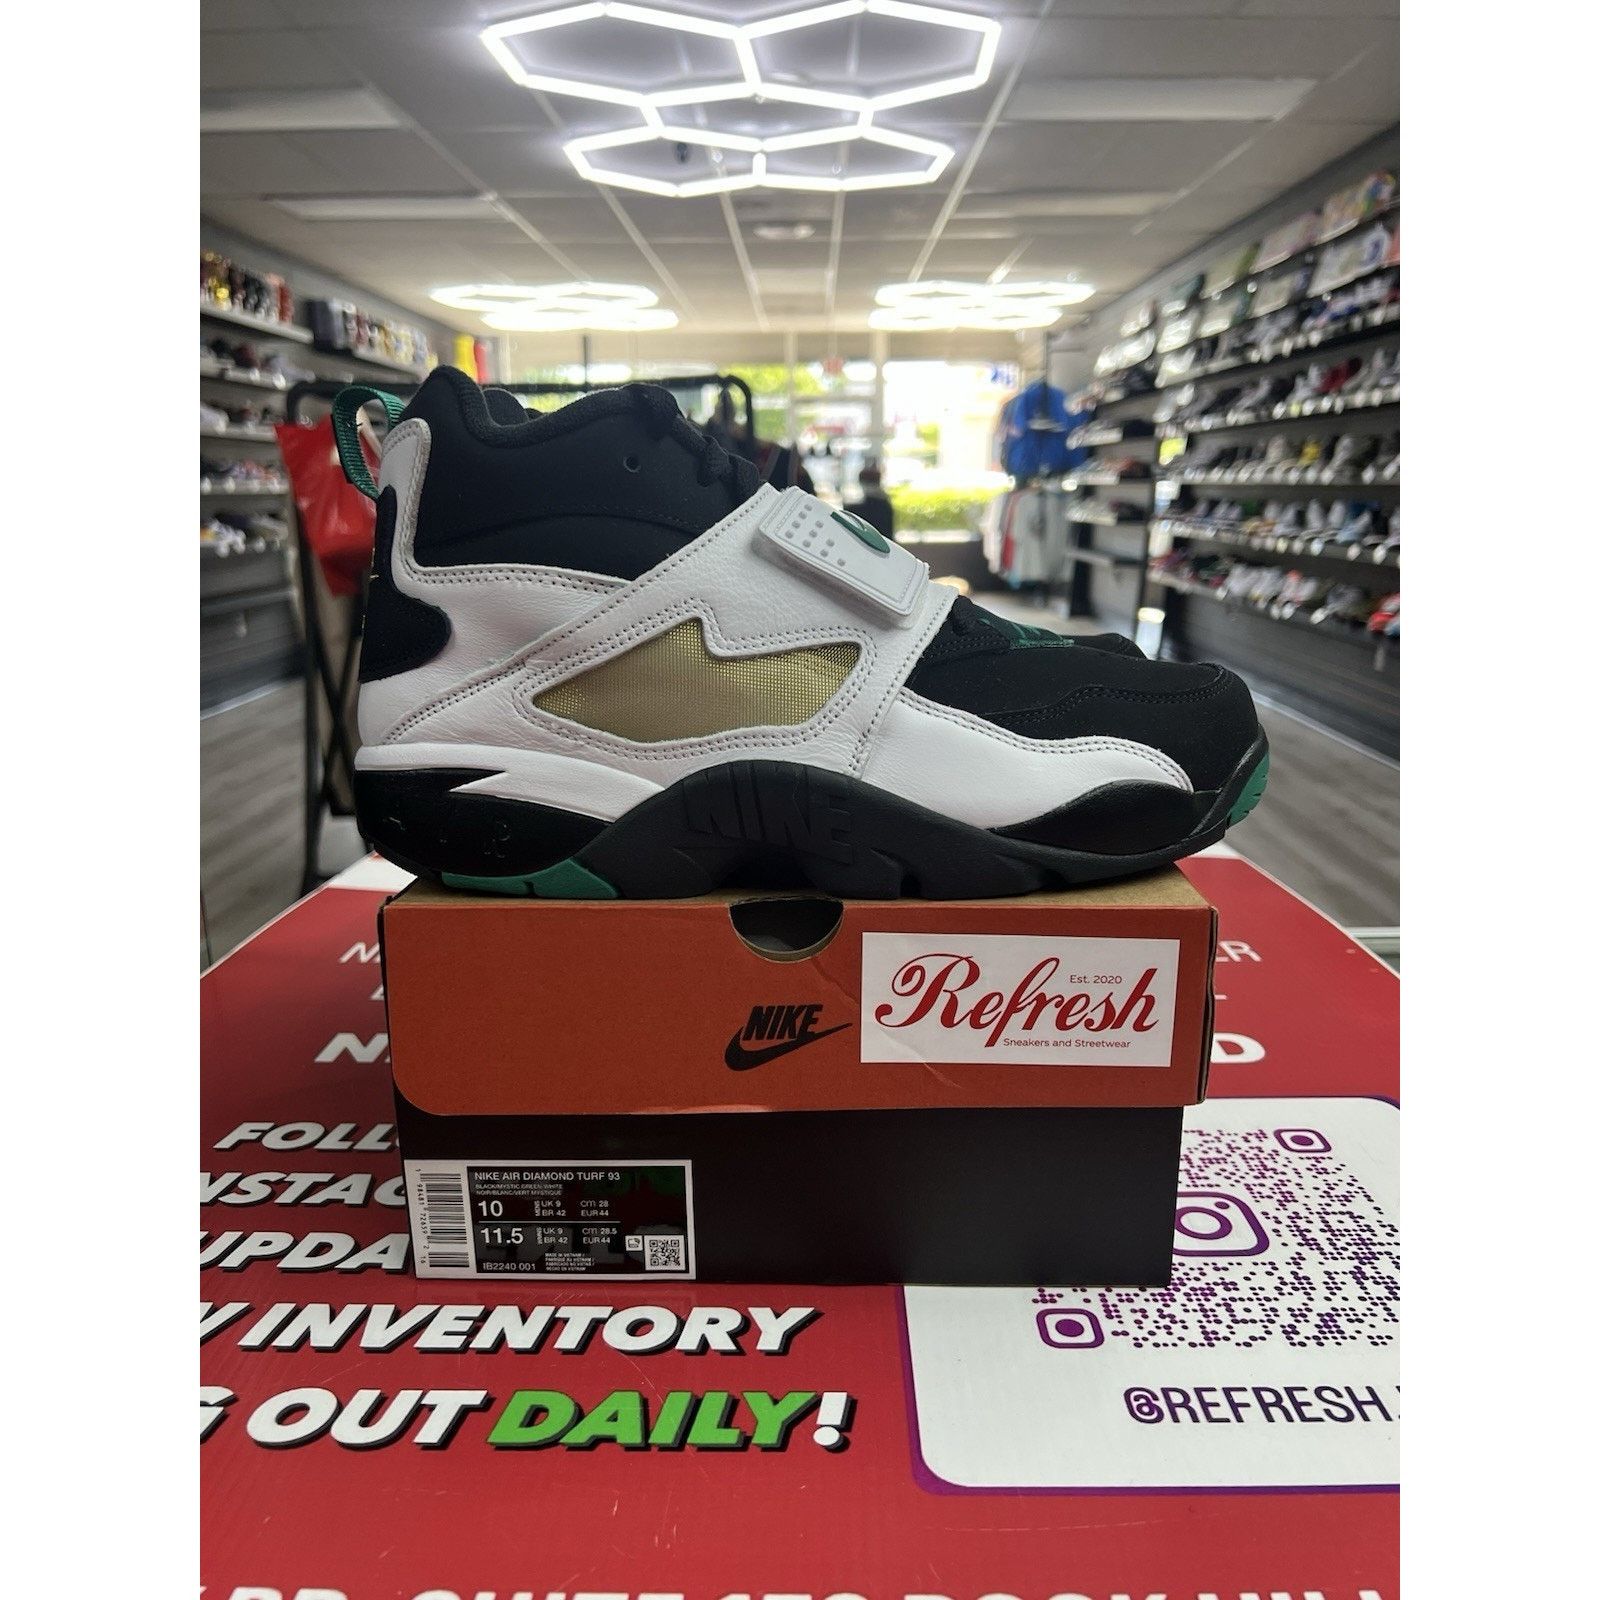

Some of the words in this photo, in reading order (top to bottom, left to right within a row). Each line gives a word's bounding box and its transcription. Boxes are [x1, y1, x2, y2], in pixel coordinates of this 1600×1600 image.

[1069, 974, 1090, 984] Est.
[1093, 975, 1122, 984] 2020
[874, 953, 1159, 1048] Refresh
[742, 1004, 823, 1041] NIKE
[1003, 1038, 1050, 1047] Sneakers
[1052, 1039, 1072, 1047] and
[1074, 1039, 1131, 1048] Streetwear
[213, 1121, 400, 1151] FOLL
[474, 1171, 500, 1181] NIKE
[502, 1171, 521, 1181] AIR
[523, 1171, 574, 1181] DIAMOND
[577, 1171, 605, 1181] TURF
[608, 1171, 621, 1181] 93
[478, 1200, 504, 1217] 10
[541, 1200, 554, 1208] UK
[599, 1200, 609, 1208] 28
[542, 1209, 554, 1217] BR
[556, 1209, 567, 1217] 42
[581, 1209, 599, 1217] EUR
[599, 1209, 609, 1217] 44
[480, 1227, 524, 1245] 11.5
[543, 1227, 556, 1235] UK
[600, 1227, 618, 1235] 28.5
[482, 1262, 517, 1271] IB2240
[519, 1262, 536, 1271] 001
[237, 1302, 816, 1352] INVENTORY
[246, 1387, 490, 1446] OUT
[487, 1389, 853, 1449] DAILY!
